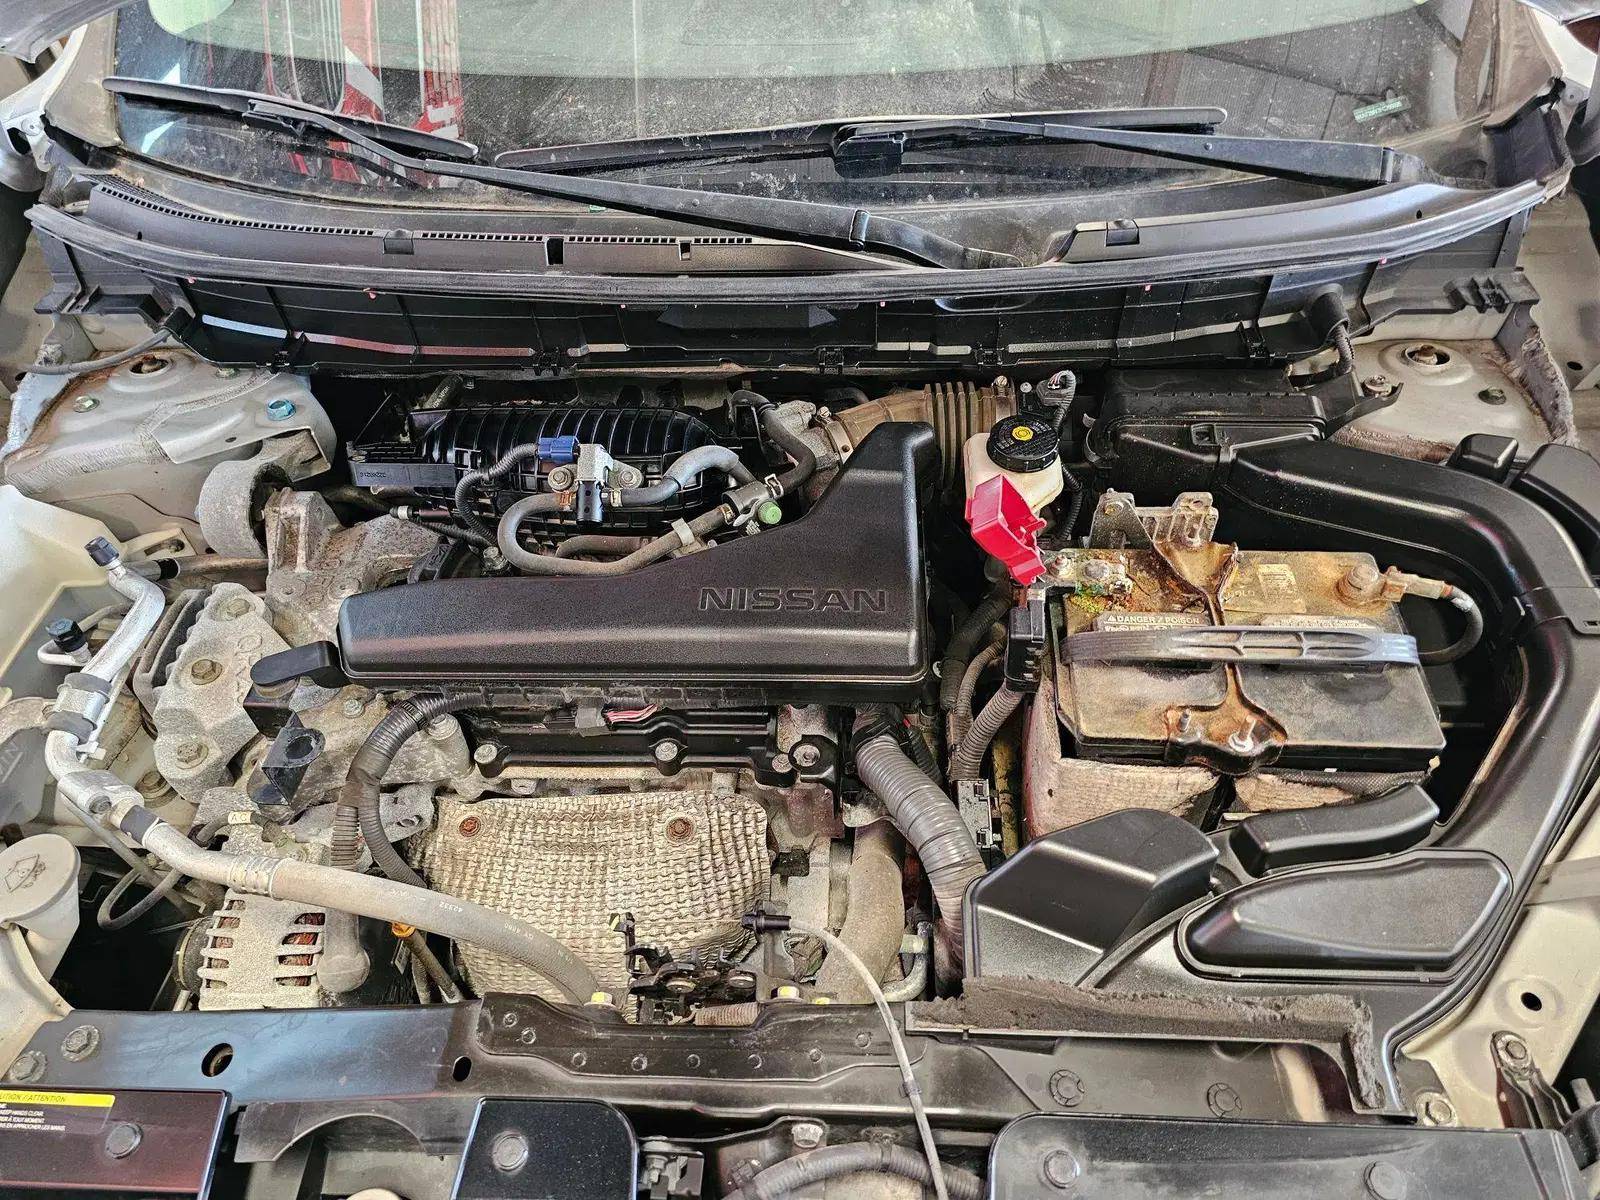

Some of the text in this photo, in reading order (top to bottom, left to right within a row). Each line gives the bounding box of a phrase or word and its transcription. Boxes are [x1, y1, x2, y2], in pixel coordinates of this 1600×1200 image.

[699, 586, 887, 612] NISSAN
[1117, 614, 1156, 624] DANGER
[1165, 616, 1200, 625] POISON
[27, 1093, 66, 1103] ATTENTION
